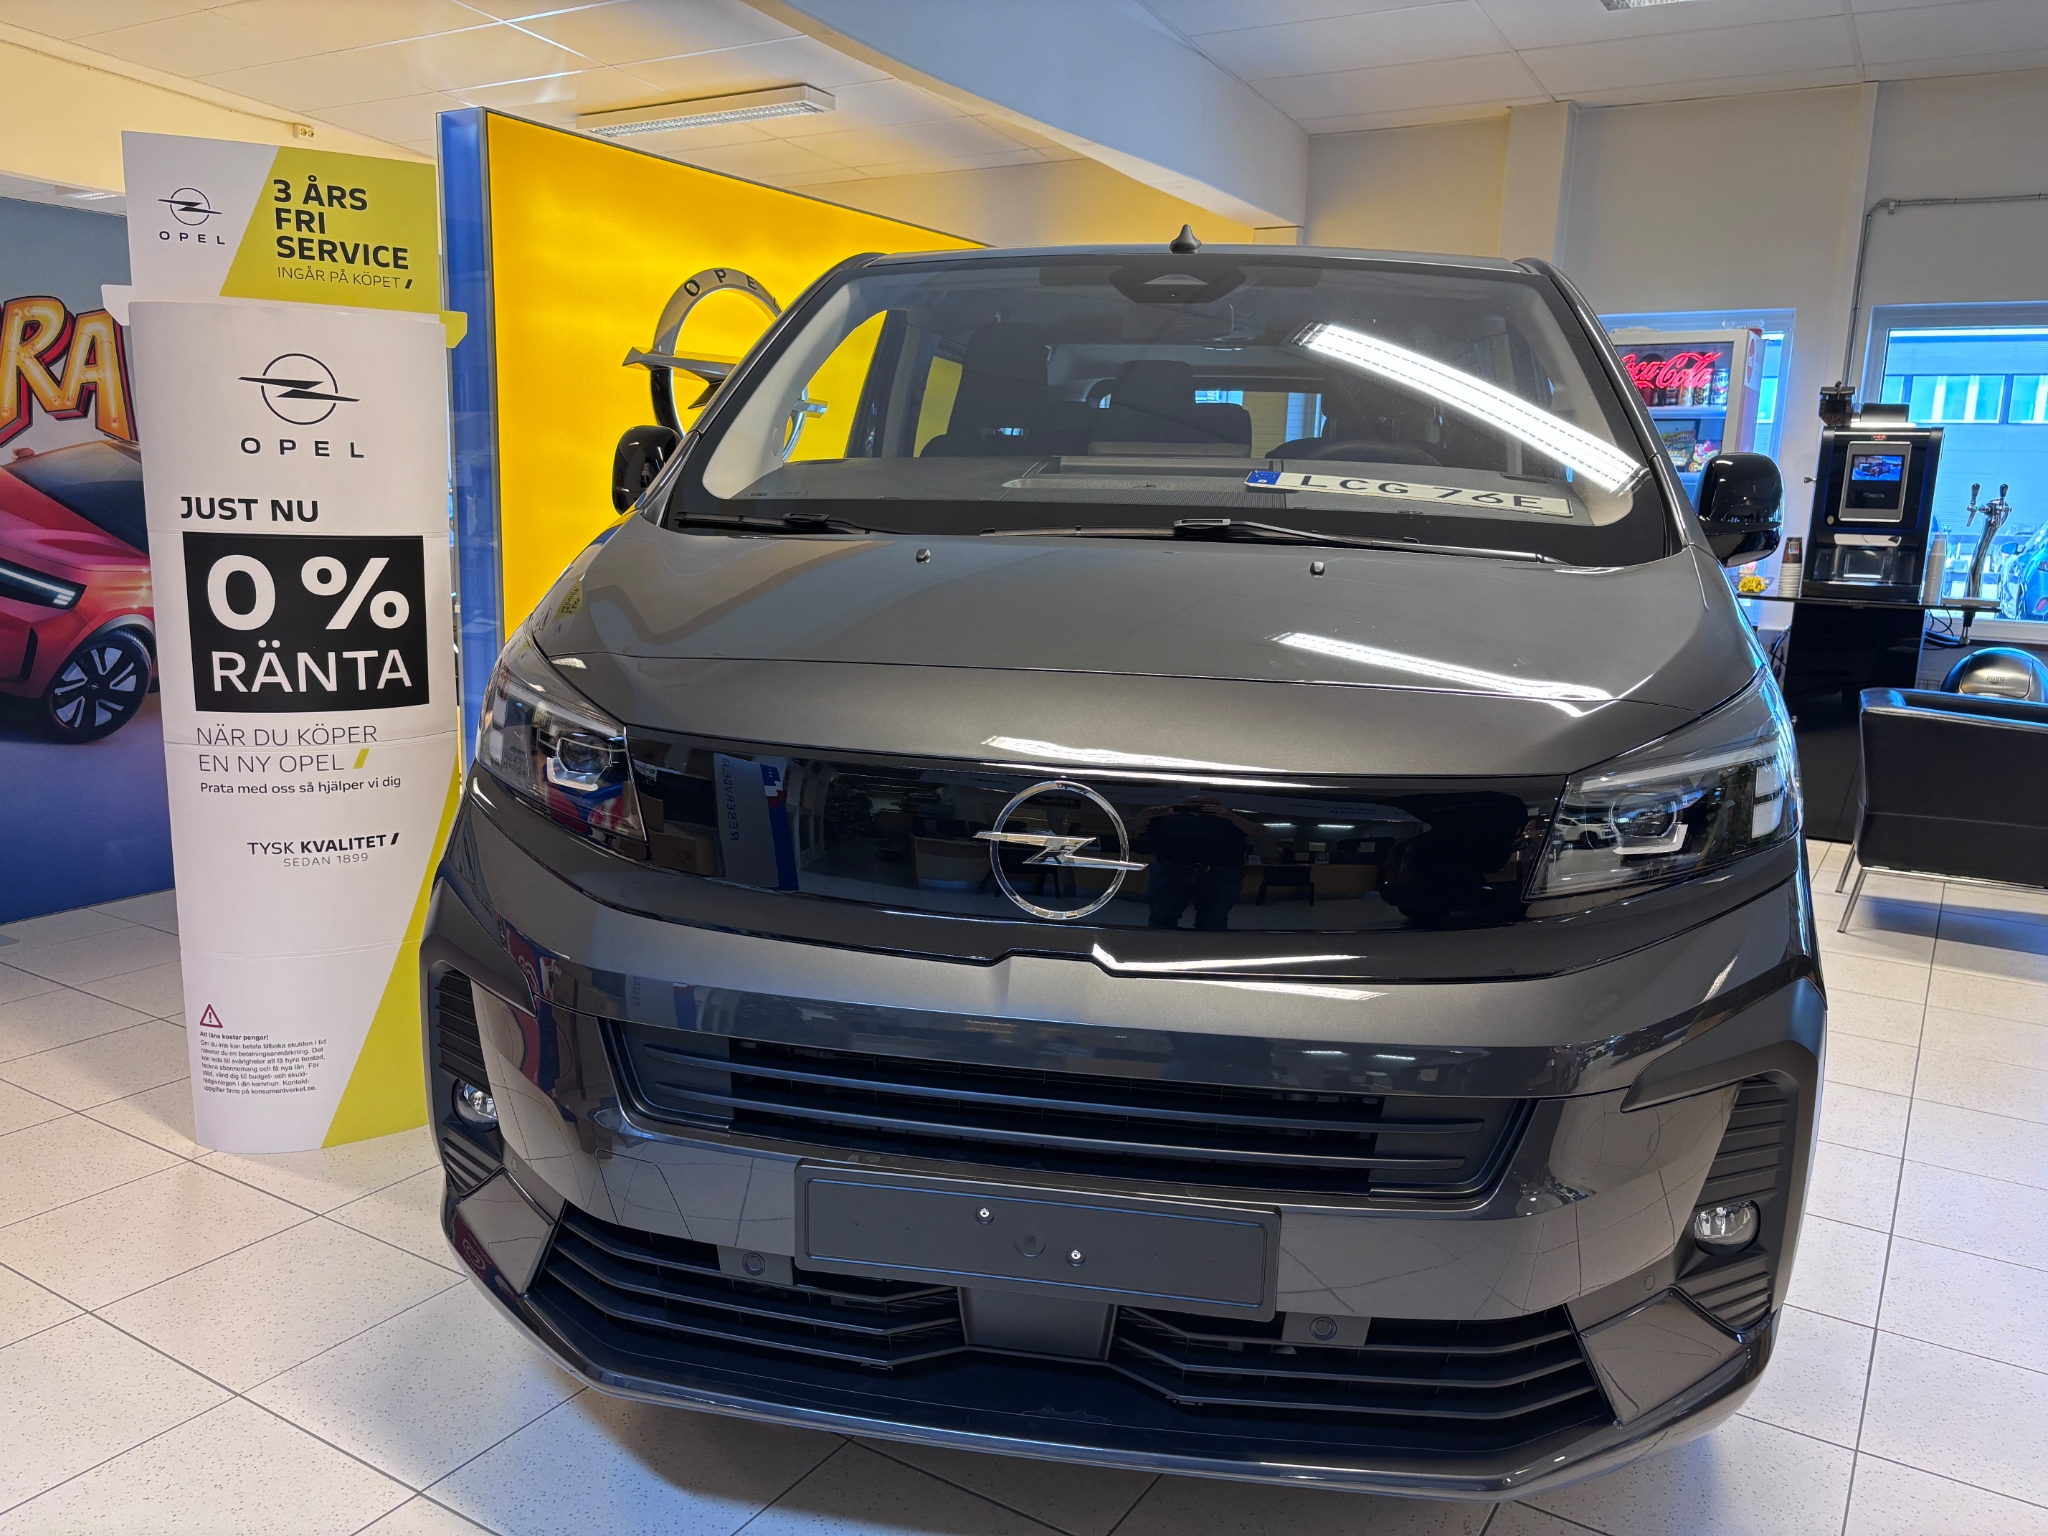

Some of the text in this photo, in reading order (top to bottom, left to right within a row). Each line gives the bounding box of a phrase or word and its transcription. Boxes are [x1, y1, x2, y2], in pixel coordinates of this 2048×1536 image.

[273, 175, 369, 211] 3 ÅRS
[275, 208, 326, 234] FRI
[158, 230, 227, 246] OPEL
[275, 236, 409, 271] SERVICE
[277, 266, 401, 289] INGÅR PÅ KÖPET
[240, 437, 365, 459] OPEL
[1300, 475, 1544, 509] LCG 76E
[180, 496, 319, 523] JUST NU
[207, 554, 410, 631] 0 %
[212, 639, 412, 693] RÄNTA
[197, 723, 377, 746] NÄR DU KÖPER
[199, 754, 344, 773] EN NY OPEL
[201, 776, 401, 796] Prata med oss så hjälper vi dig
[247, 834, 386, 855] TYSK KVALITET
[283, 853, 369, 868] SEDAN 1899
